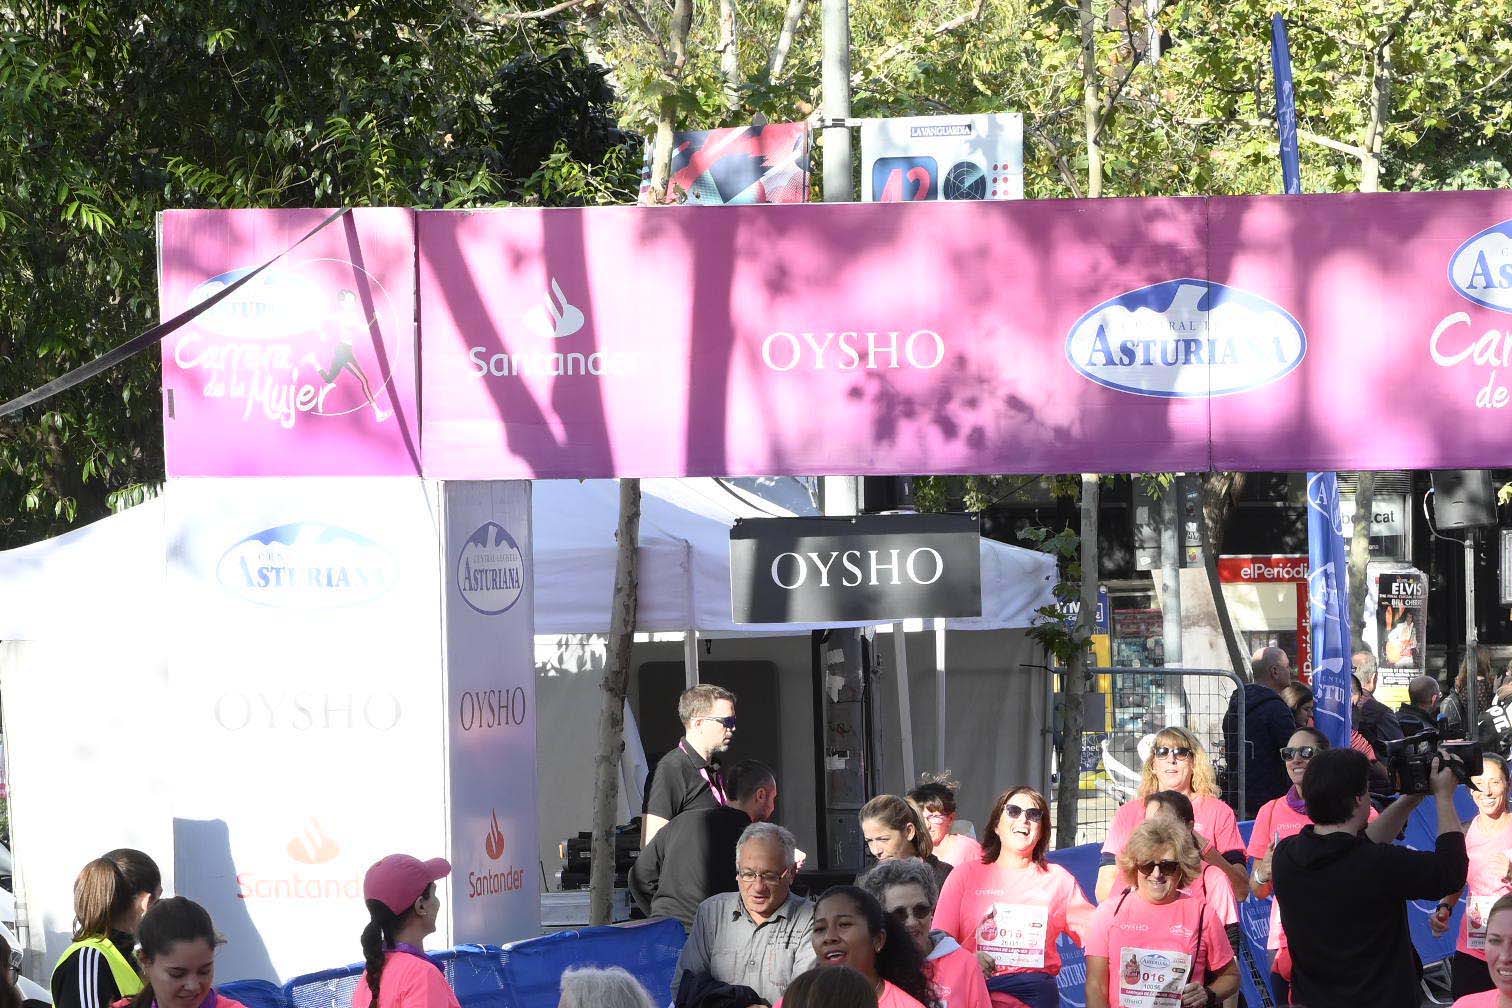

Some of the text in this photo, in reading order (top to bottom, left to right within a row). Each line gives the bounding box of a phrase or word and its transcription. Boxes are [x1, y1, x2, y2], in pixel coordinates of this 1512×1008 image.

[921, 126, 970, 136] VANGUARDIA
[469, 344, 640, 378] Santand
[761, 329, 945, 373] OYSHO
[1085, 323, 1288, 369] ASTURIAA
[1475, 370, 1511, 409] de
[462, 554, 521, 592] ASTURIANA
[770, 547, 944, 590] OYSHO
[1391, 582, 1422, 596] ELVIS
[213, 691, 406, 731] OYSHO
[459, 686, 527, 732] OYSHO
[468, 867, 524, 899] Santander
[1142, 972, 1164, 983] 016
